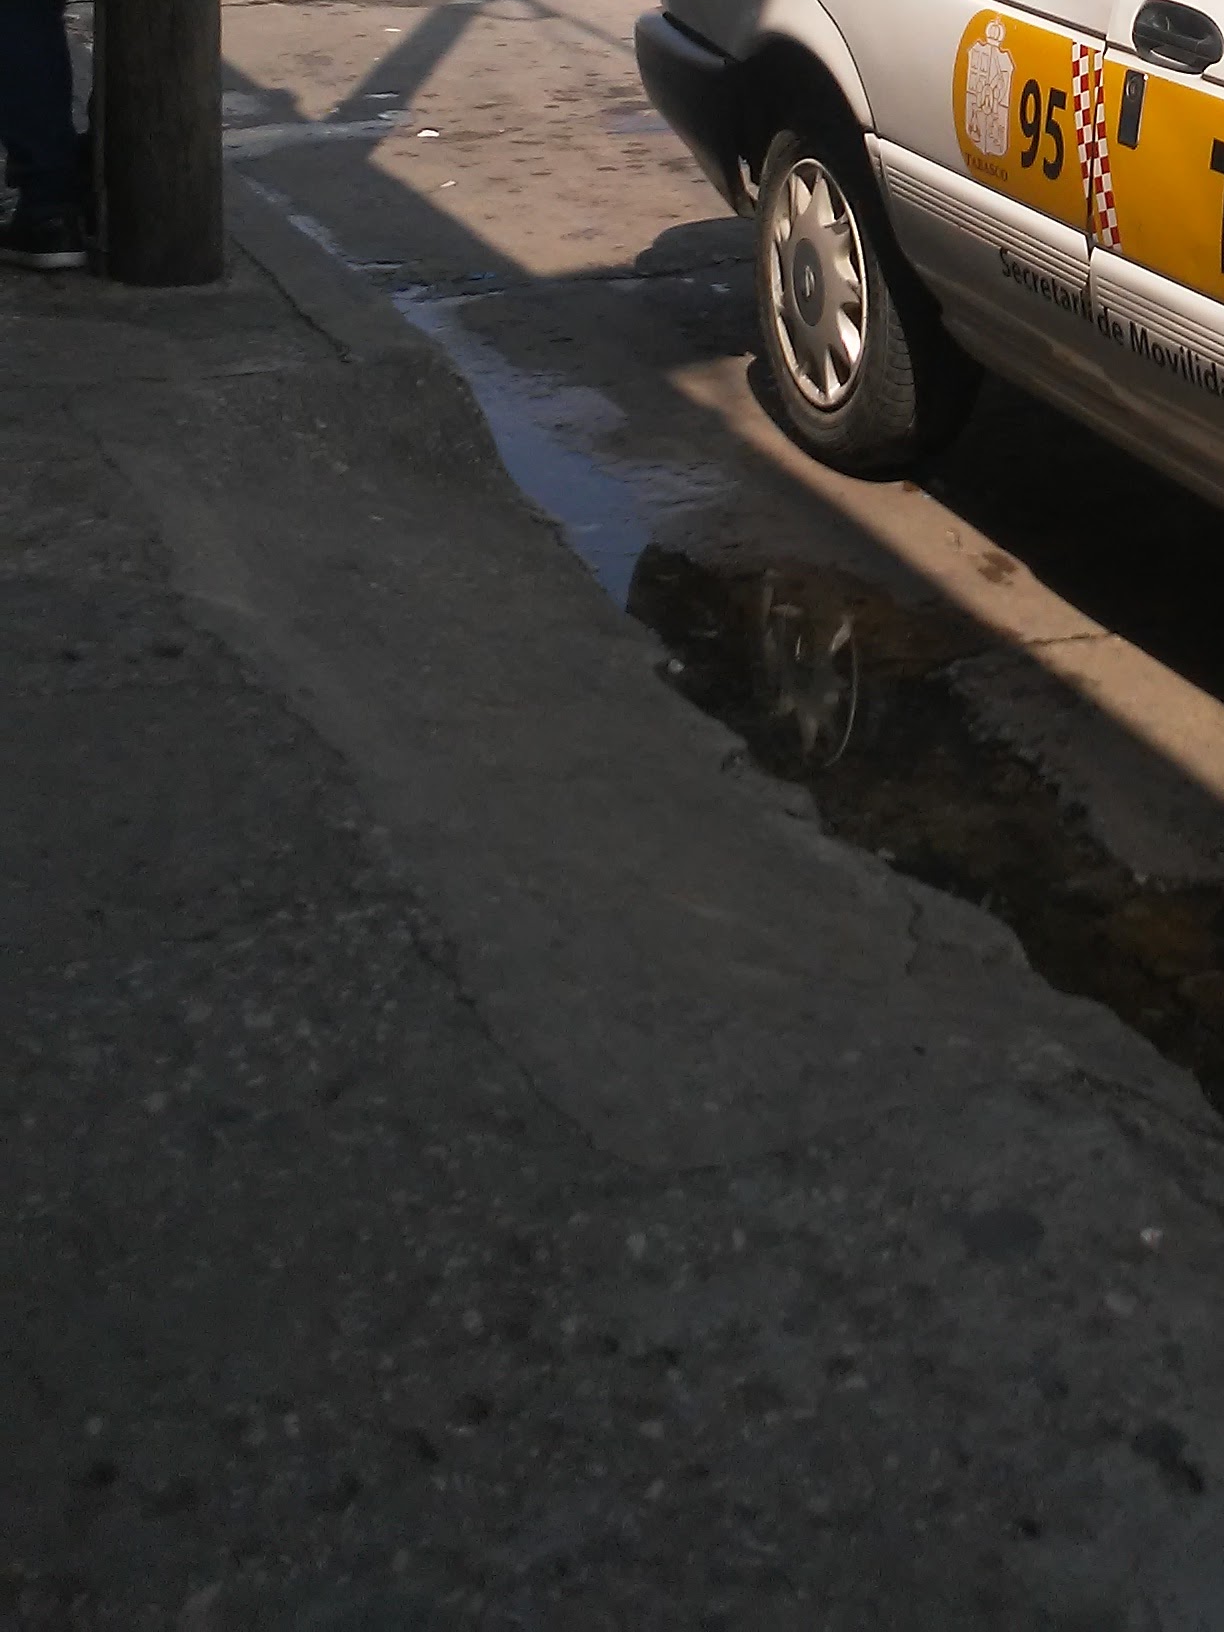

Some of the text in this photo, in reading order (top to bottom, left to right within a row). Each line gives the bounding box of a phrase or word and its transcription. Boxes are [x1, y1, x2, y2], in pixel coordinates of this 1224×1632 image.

[1019, 78, 1068, 181] 95
[965, 151, 1009, 182] TABASCO
[1097, 305, 1125, 347] de
